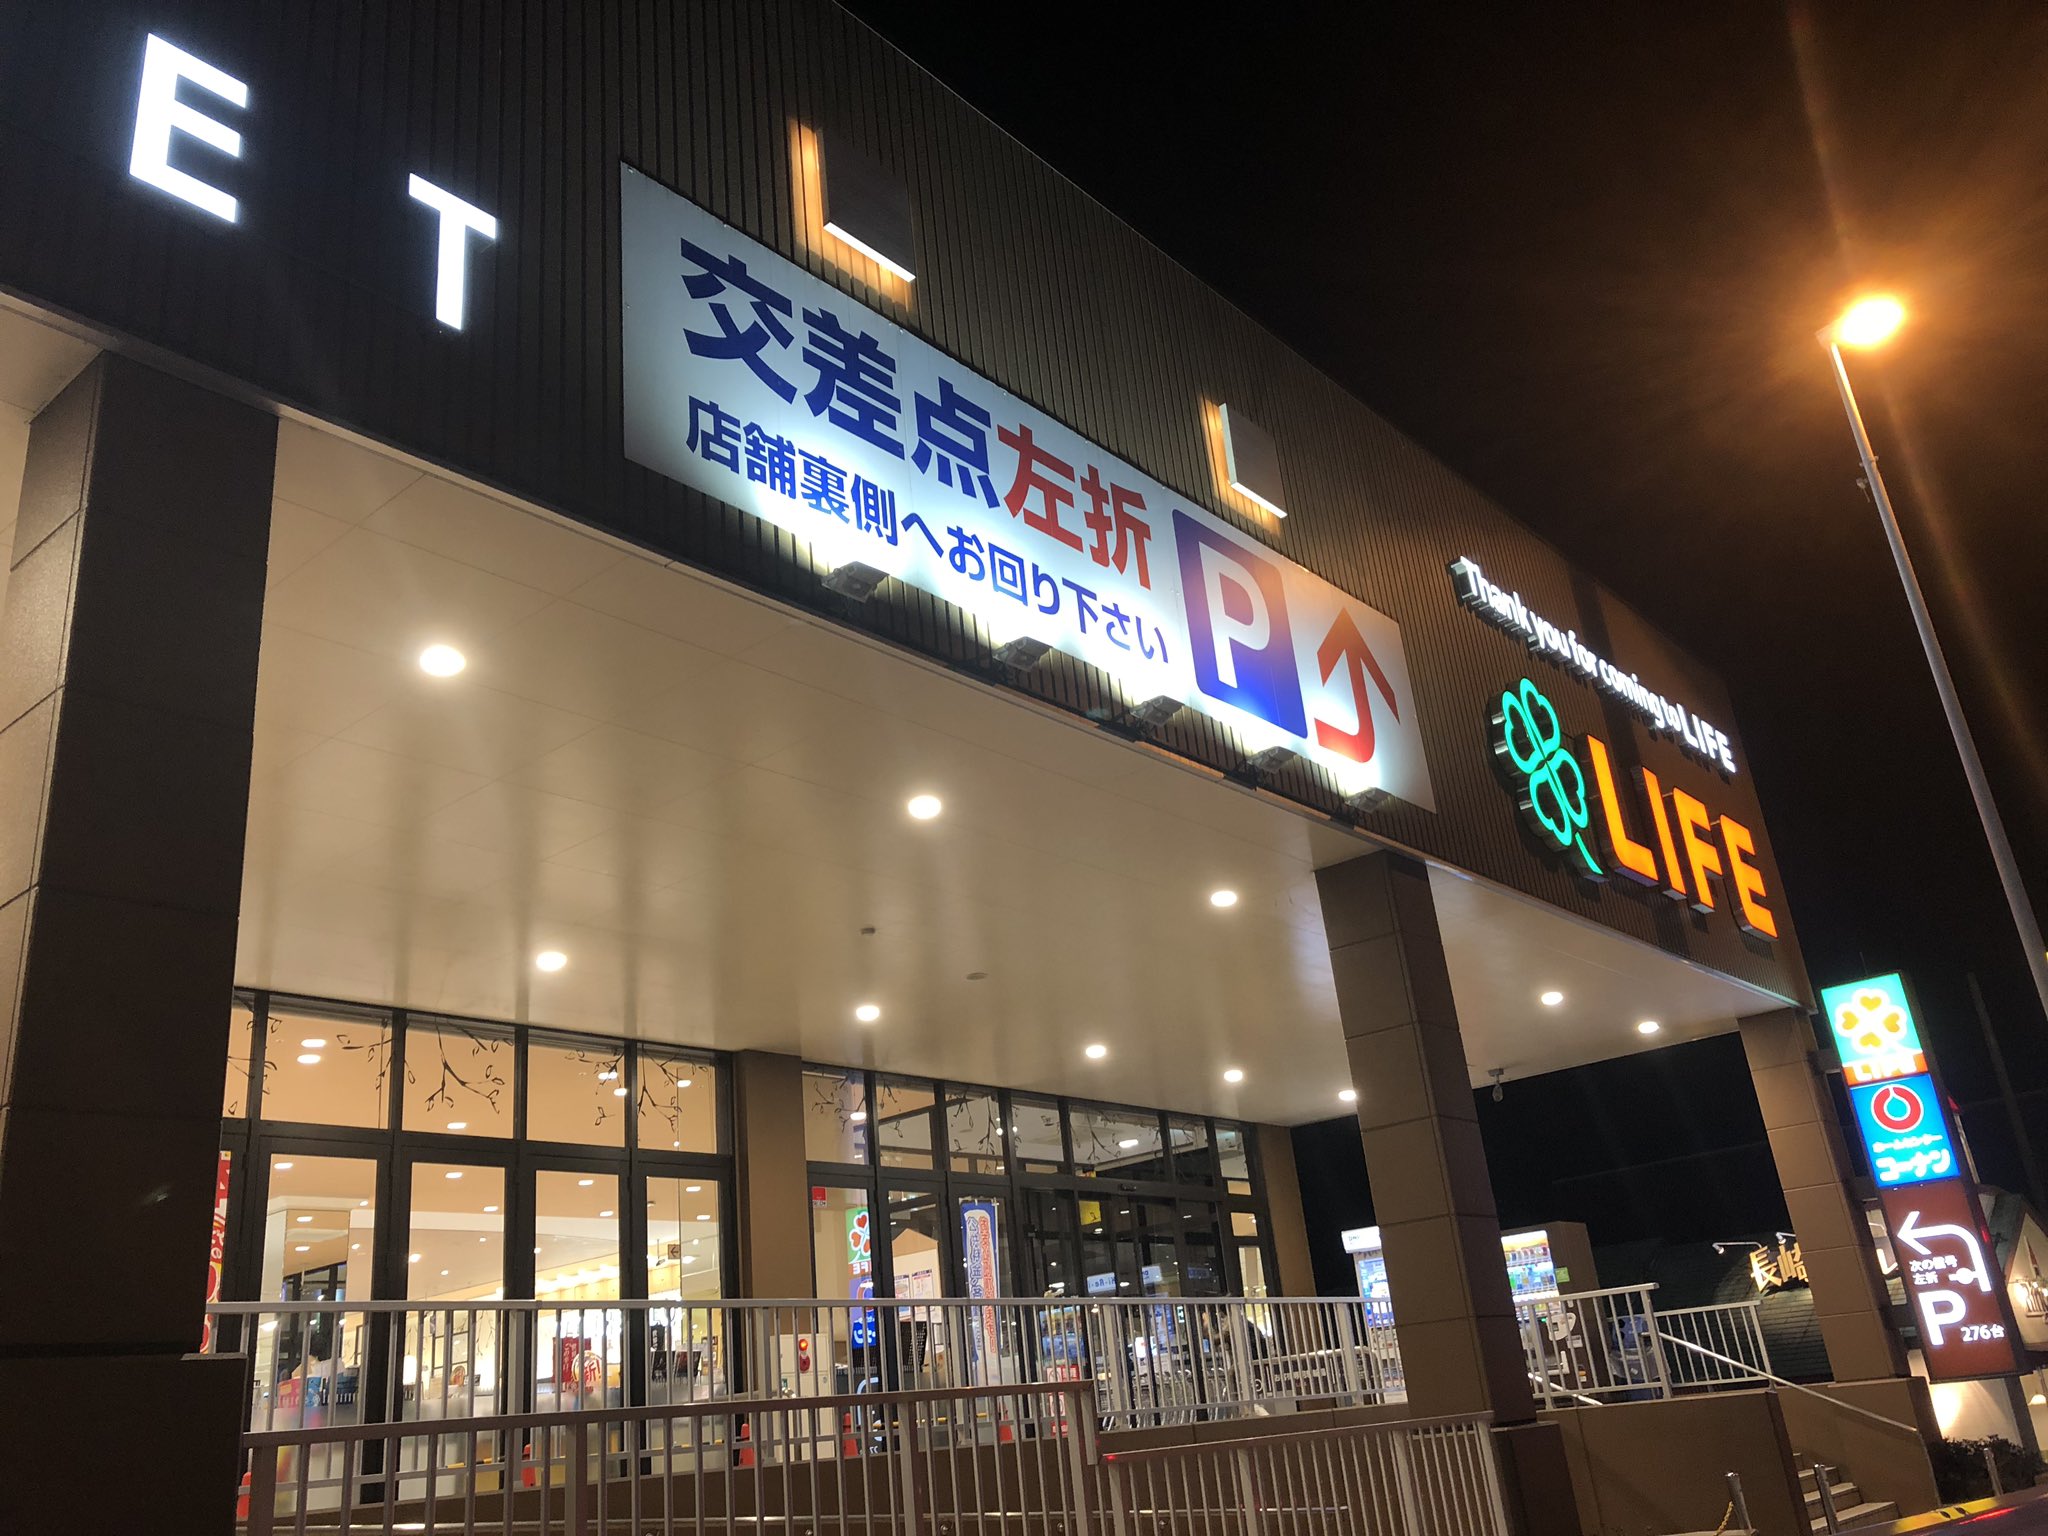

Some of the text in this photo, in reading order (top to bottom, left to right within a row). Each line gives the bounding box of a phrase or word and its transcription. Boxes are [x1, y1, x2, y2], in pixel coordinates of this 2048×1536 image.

[680, 237, 1152, 590] 交差点左折
[685, 394, 1169, 664] 店舗裏側へお回り下さい
[1199, 541, 1270, 689] P
[1459, 555, 1737, 774] Thank you for coming to LIFE
[1587, 734, 1778, 938] LIFE
[1875, 1149, 1951, 1182] コーナン
[1909, 1254, 1958, 1272] 次の信号
[1912, 1271, 1938, 1285] 左折
[1918, 1290, 1967, 1346] P
[1961, 1324, 2005, 1342] 276台
